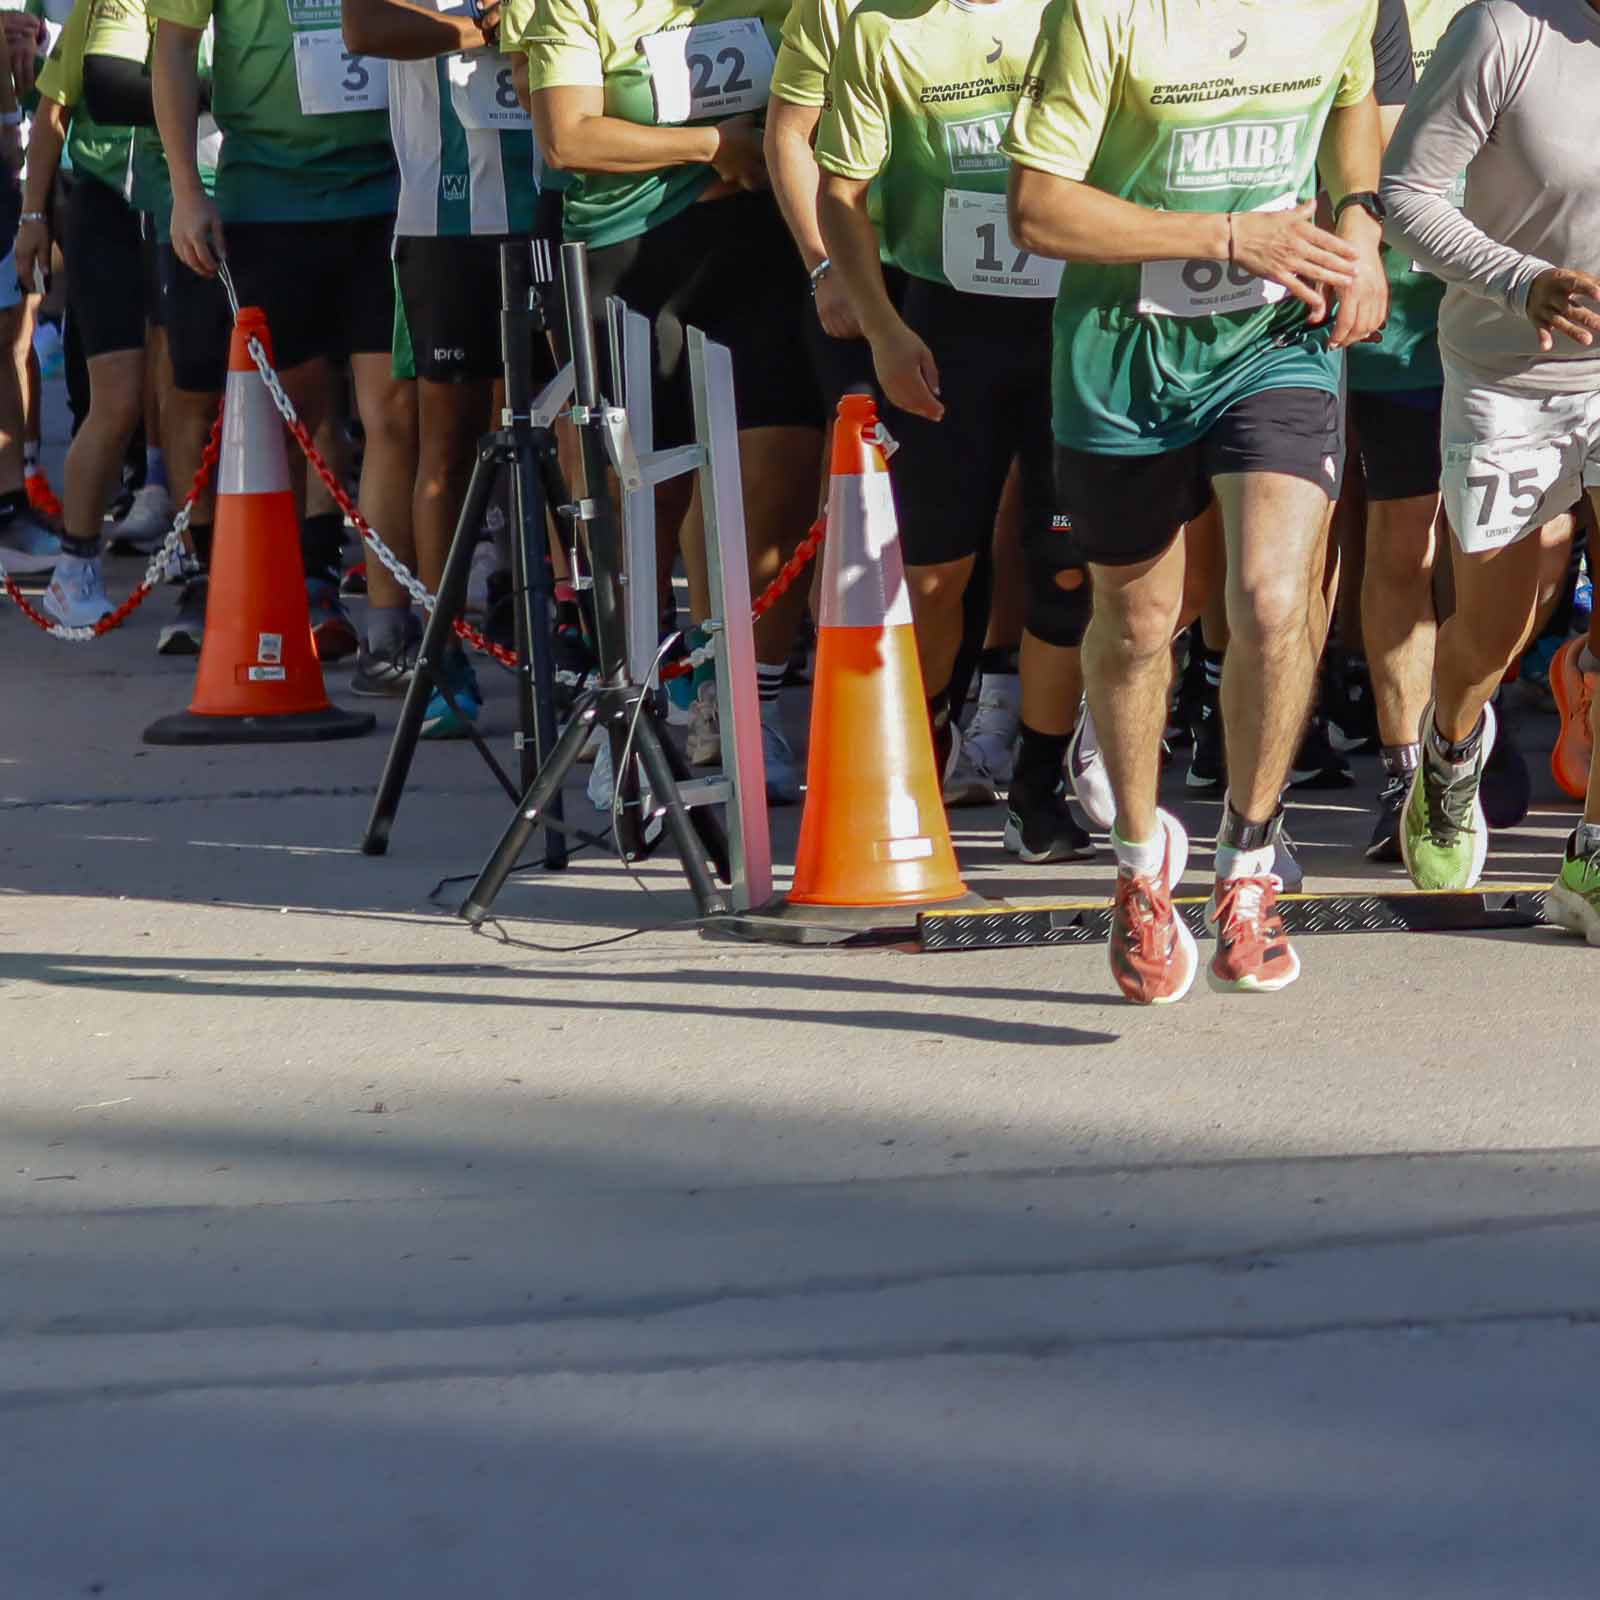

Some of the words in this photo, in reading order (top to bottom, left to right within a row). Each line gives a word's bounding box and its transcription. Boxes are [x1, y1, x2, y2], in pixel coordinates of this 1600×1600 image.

[340, 52, 370, 91] 3
[687, 47, 753, 99] 22
[1176, 119, 1298, 174] MAIRA
[1465, 467, 1546, 527] 75
